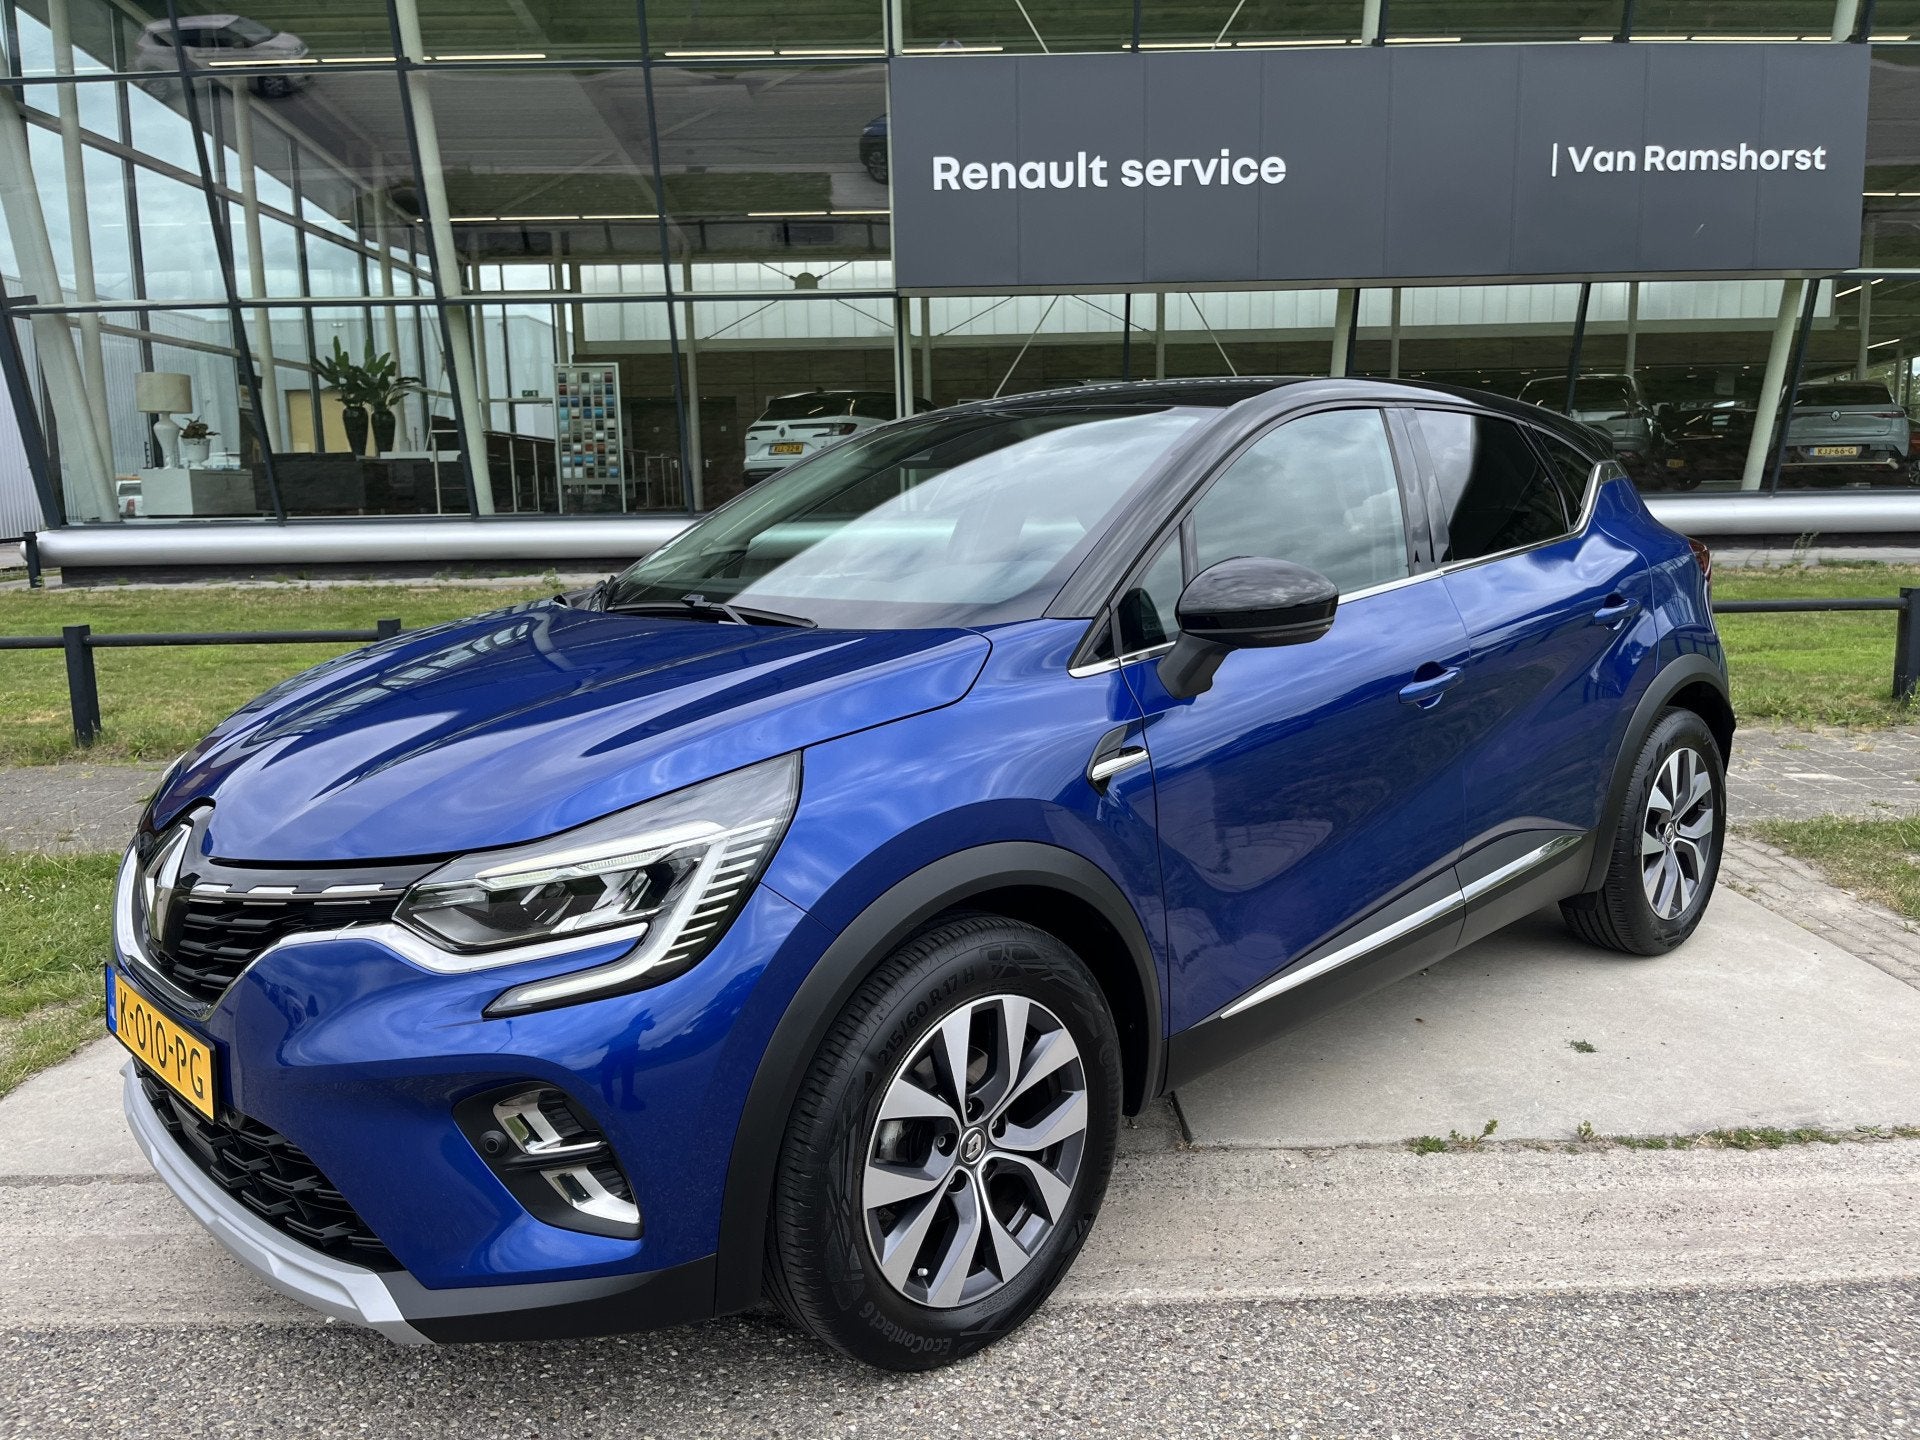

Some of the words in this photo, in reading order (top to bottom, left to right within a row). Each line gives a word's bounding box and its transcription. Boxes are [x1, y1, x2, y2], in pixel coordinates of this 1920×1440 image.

[932, 151, 1108, 190] Renault
[1120, 148, 1286, 188] service
[1567, 146, 1636, 173] Van
[1643, 143, 1826, 172] Ramshorst
[1817, 447, 1854, 455] KJJ-66-G
[878, 1000, 929, 1066] 215/60
[929, 988, 943, 1006] R
[943, 974, 958, 996] 17
[119, 986, 206, 1100] K-010-PG
[858, 1301, 875, 1319] 6
[868, 1310, 953, 1356] EcoContact
